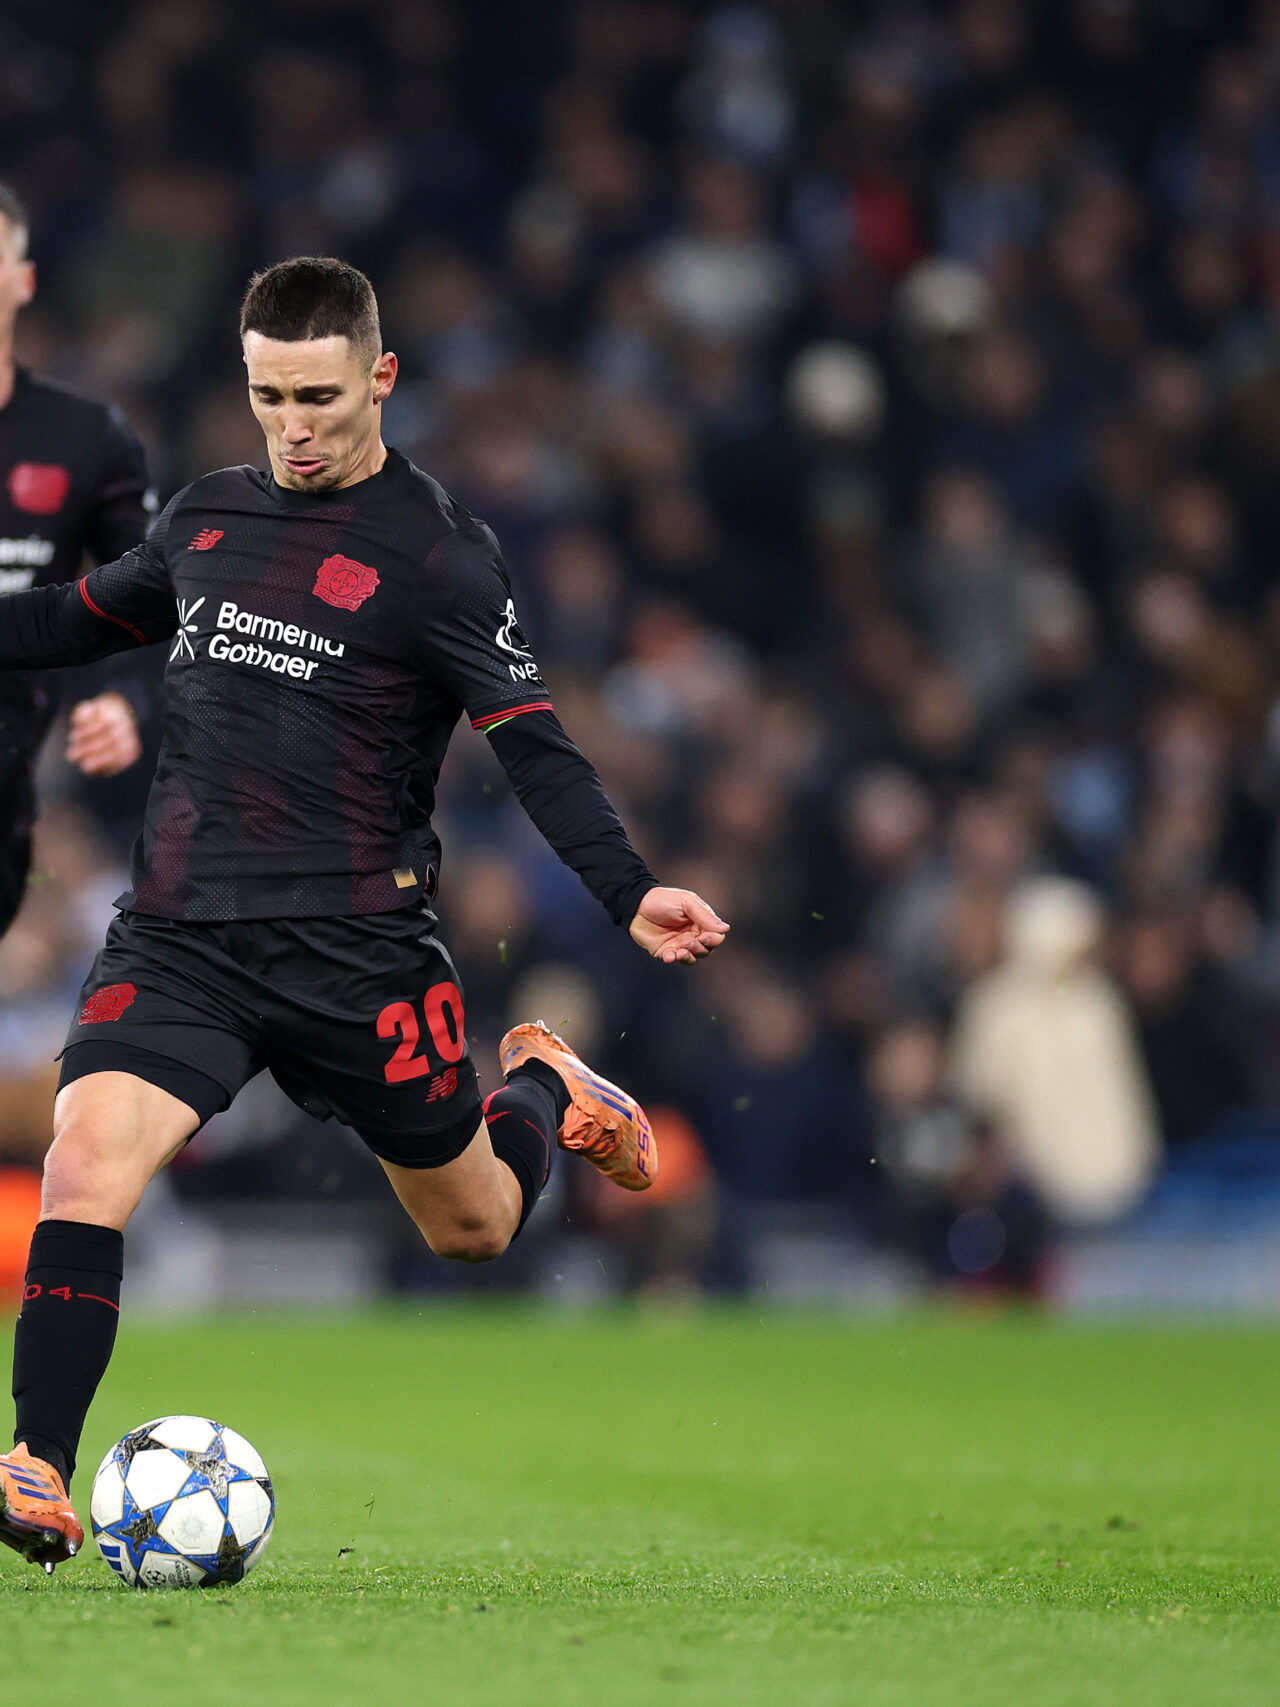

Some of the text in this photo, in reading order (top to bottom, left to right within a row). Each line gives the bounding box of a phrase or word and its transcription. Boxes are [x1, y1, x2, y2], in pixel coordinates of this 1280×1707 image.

[208, 633, 319, 681] Gothaer
[216, 601, 345, 658] Barmenia
[376, 982, 465, 1083] 20
